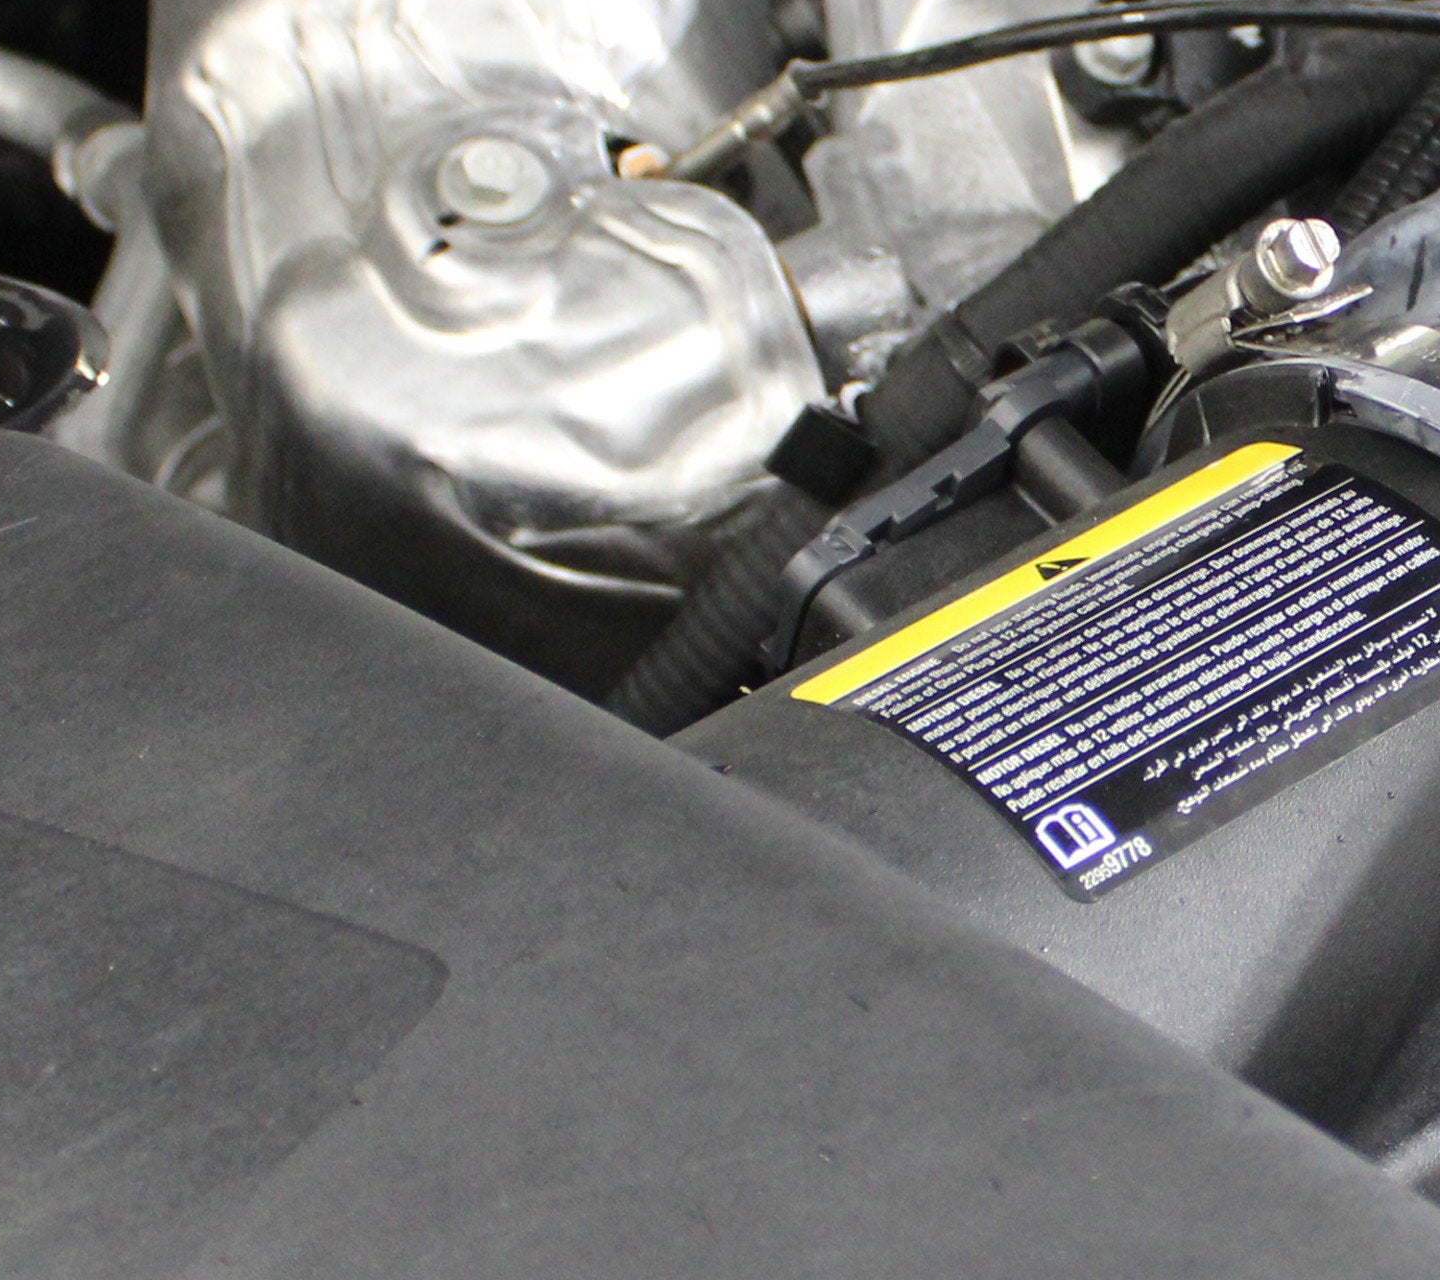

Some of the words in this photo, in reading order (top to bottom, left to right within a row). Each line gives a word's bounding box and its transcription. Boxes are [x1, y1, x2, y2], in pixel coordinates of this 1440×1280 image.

[905, 701, 961, 733] MOTEUR
[955, 680, 1003, 707] DIESEL
[1022, 655, 1048, 672] pas
[1082, 626, 1102, 639] de
[1134, 597, 1154, 610] de
[1207, 554, 1235, 570] Des
[1231, 524, 1291, 559] dommages
[1339, 489, 1357, 501] au
[922, 715, 965, 743] moteur
[963, 683, 1025, 722] pourraient
[1021, 675, 1041, 688] en
[1100, 629, 1125, 647] pas
[1121, 602, 1174, 634] appliquer
[1171, 591, 1197, 607] une
[1191, 570, 1236, 596] tension
[1231, 545, 1283, 575] nominale
[1279, 537, 1297, 550] de
[1293, 525, 1320, 543] plus
[1316, 517, 1335, 530] de
[1329, 508, 1350, 521] 12
[936, 738, 957, 753] au
[952, 712, 1005, 744] système
[1000, 681, 1060, 717] électrique
[1056, 656, 1106, 689] pendant
[1099, 650, 1118, 662] la
[1114, 630, 1156, 656] charge
[1151, 622, 1171, 635] ou
[1164, 615, 1183, 628] le
[1179, 585, 1240, 621] démarrage
[1234, 580, 1249, 590] à
[1301, 528, 1345, 553] batterie
[948, 751, 964, 764] Il
[959, 728, 1008, 761] pourrait
[1003, 720, 1023, 735] en
[1018, 697, 1064, 726] résulter
[1061, 685, 1087, 703] une
[1082, 655, 1143, 691] défaillance
[1139, 647, 1159, 661] du
[1155, 622, 1204, 653] système
[1200, 614, 1219, 628] de
[1215, 583, 1276, 620] démarrage
[1270, 578, 1285, 589] à
[1278, 556, 1325, 584] bougies
[1320, 548, 1340, 562] de
[975, 753, 1025, 785] MOTOR
[1018, 732, 1067, 762] DIESEL
[1063, 722, 1086, 737] No
[1082, 710, 1108, 728] use
[1139, 653, 1216, 697] arrancadores.
[1209, 633, 1248, 657] Puede
[1244, 610, 1287, 639] resultar
[1284, 603, 1303, 617] en
[1297, 586, 1333, 609] daños
[1327, 556, 1387, 592] inmediatos
[1382, 548, 1398, 562] al
[1393, 534, 1430, 556] motor.
[990, 783, 1014, 799] No
[1009, 761, 1054, 790] aplique
[1049, 747, 1079, 768] más
[1075, 738, 1095, 753] de
[1090, 728, 1111, 744] 12
[1106, 710, 1146, 736] voltios
[1141, 701, 1158, 717] al
[1153, 679, 1201, 710] sistema
[1196, 654, 1246, 686] eléctrico
[1241, 633, 1285, 661] durante
[1278, 626, 1297, 639] la
[1292, 610, 1327, 633] carga
[1322, 605, 1335, 616] o
[1330, 597, 1346, 612] el
[1341, 575, 1389, 606] arranque
[1384, 564, 1409, 581] con
[1005, 786, 1047, 813] Puede
[1042, 762, 1089, 794] resultar
[1086, 754, 1106, 770] en
[1099, 741, 1130, 761] falla
[1125, 729, 1148, 748] del
[1141, 706, 1192, 738] Sistema
[1187, 698, 1207, 713] de
[1202, 672, 1253, 705] arranque
[1248, 664, 1268, 679] de
[1286, 610, 1367, 657] incandescente.
[1078, 835, 1153, 890] 22959778
